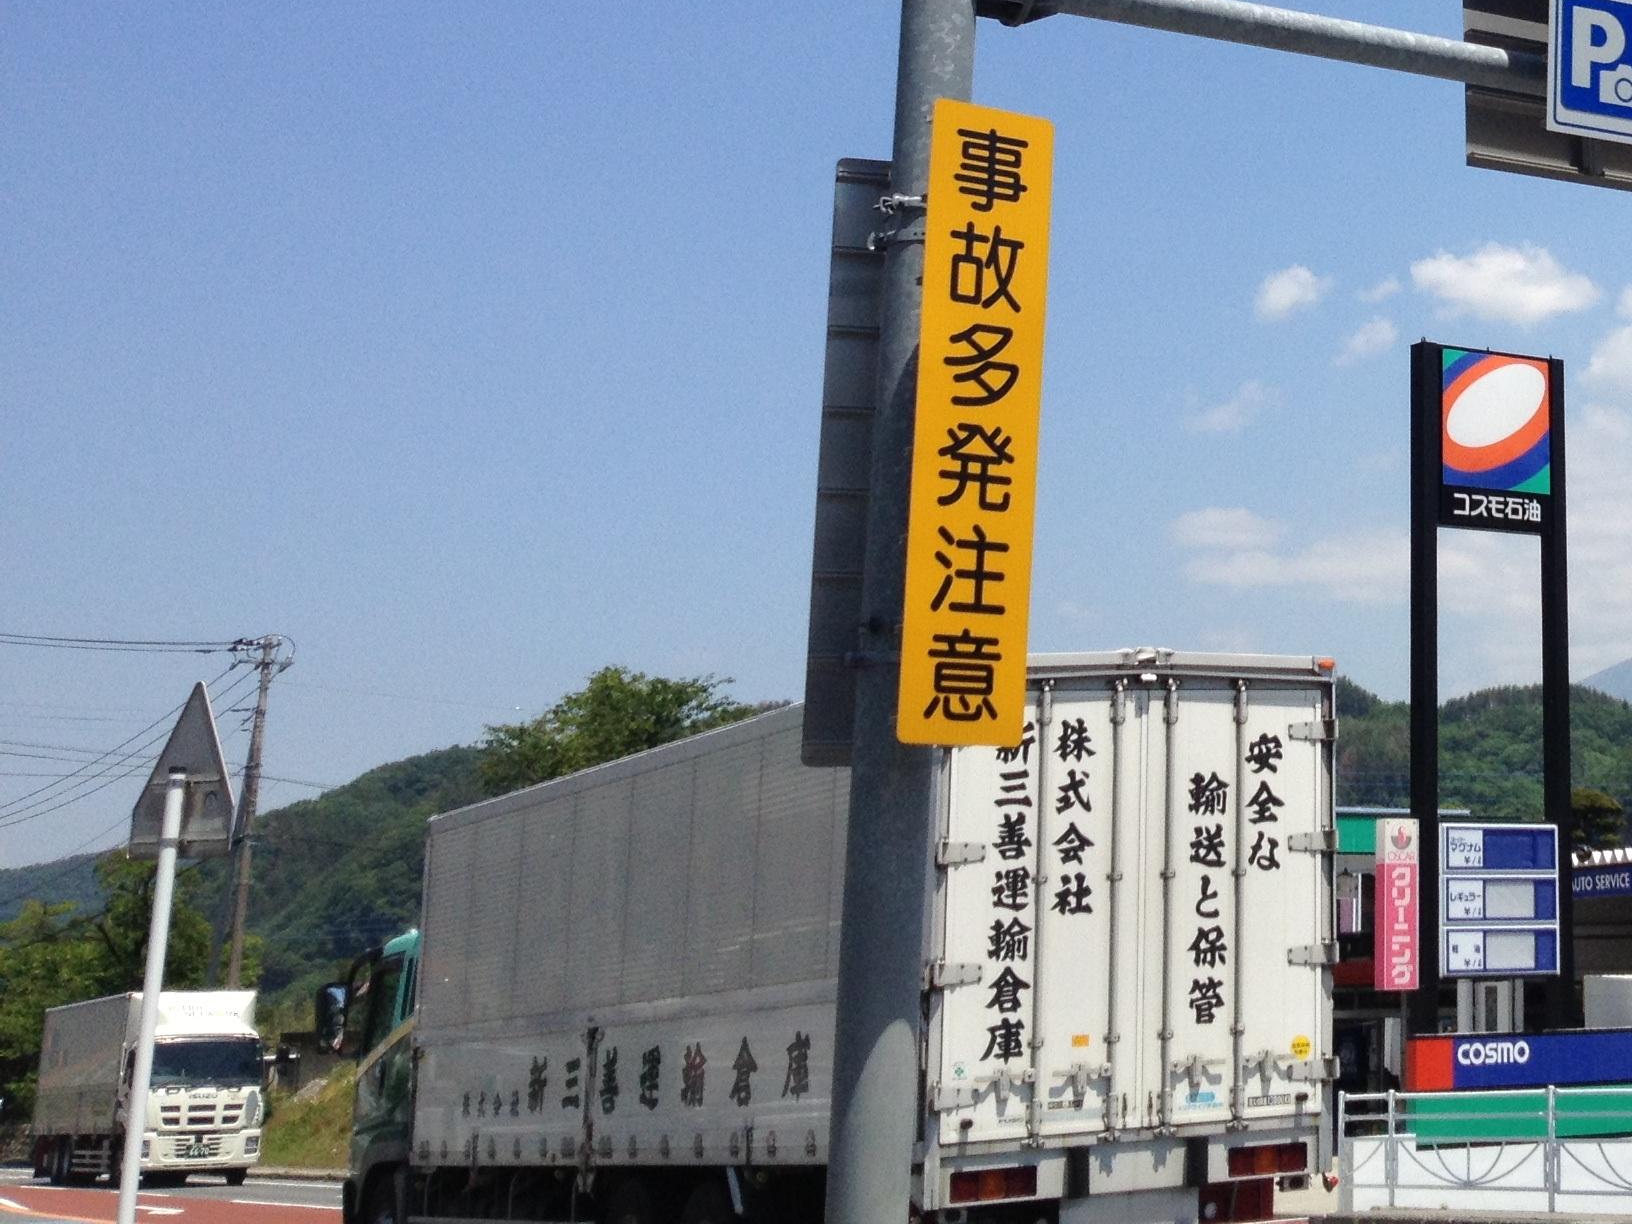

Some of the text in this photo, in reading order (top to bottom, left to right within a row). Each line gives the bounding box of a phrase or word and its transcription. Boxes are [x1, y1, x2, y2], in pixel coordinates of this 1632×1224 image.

[922, 128, 1030, 722] 事故多発注意
[1453, 492, 1542, 522] コスモ石油
[1051, 718, 1096, 916] 株式会社
[1245, 733, 1285, 872] 安全な
[1450, 842, 1482, 853] マグナム
[1595, 872, 1631, 891] SERVICE
[1188, 772, 1231, 1026] 輸送と保管
[1391, 866, 1414, 985] クリーニング
[1449, 891, 1482, 902] レギュラー
[1457, 1040, 1530, 1066] COSMO
